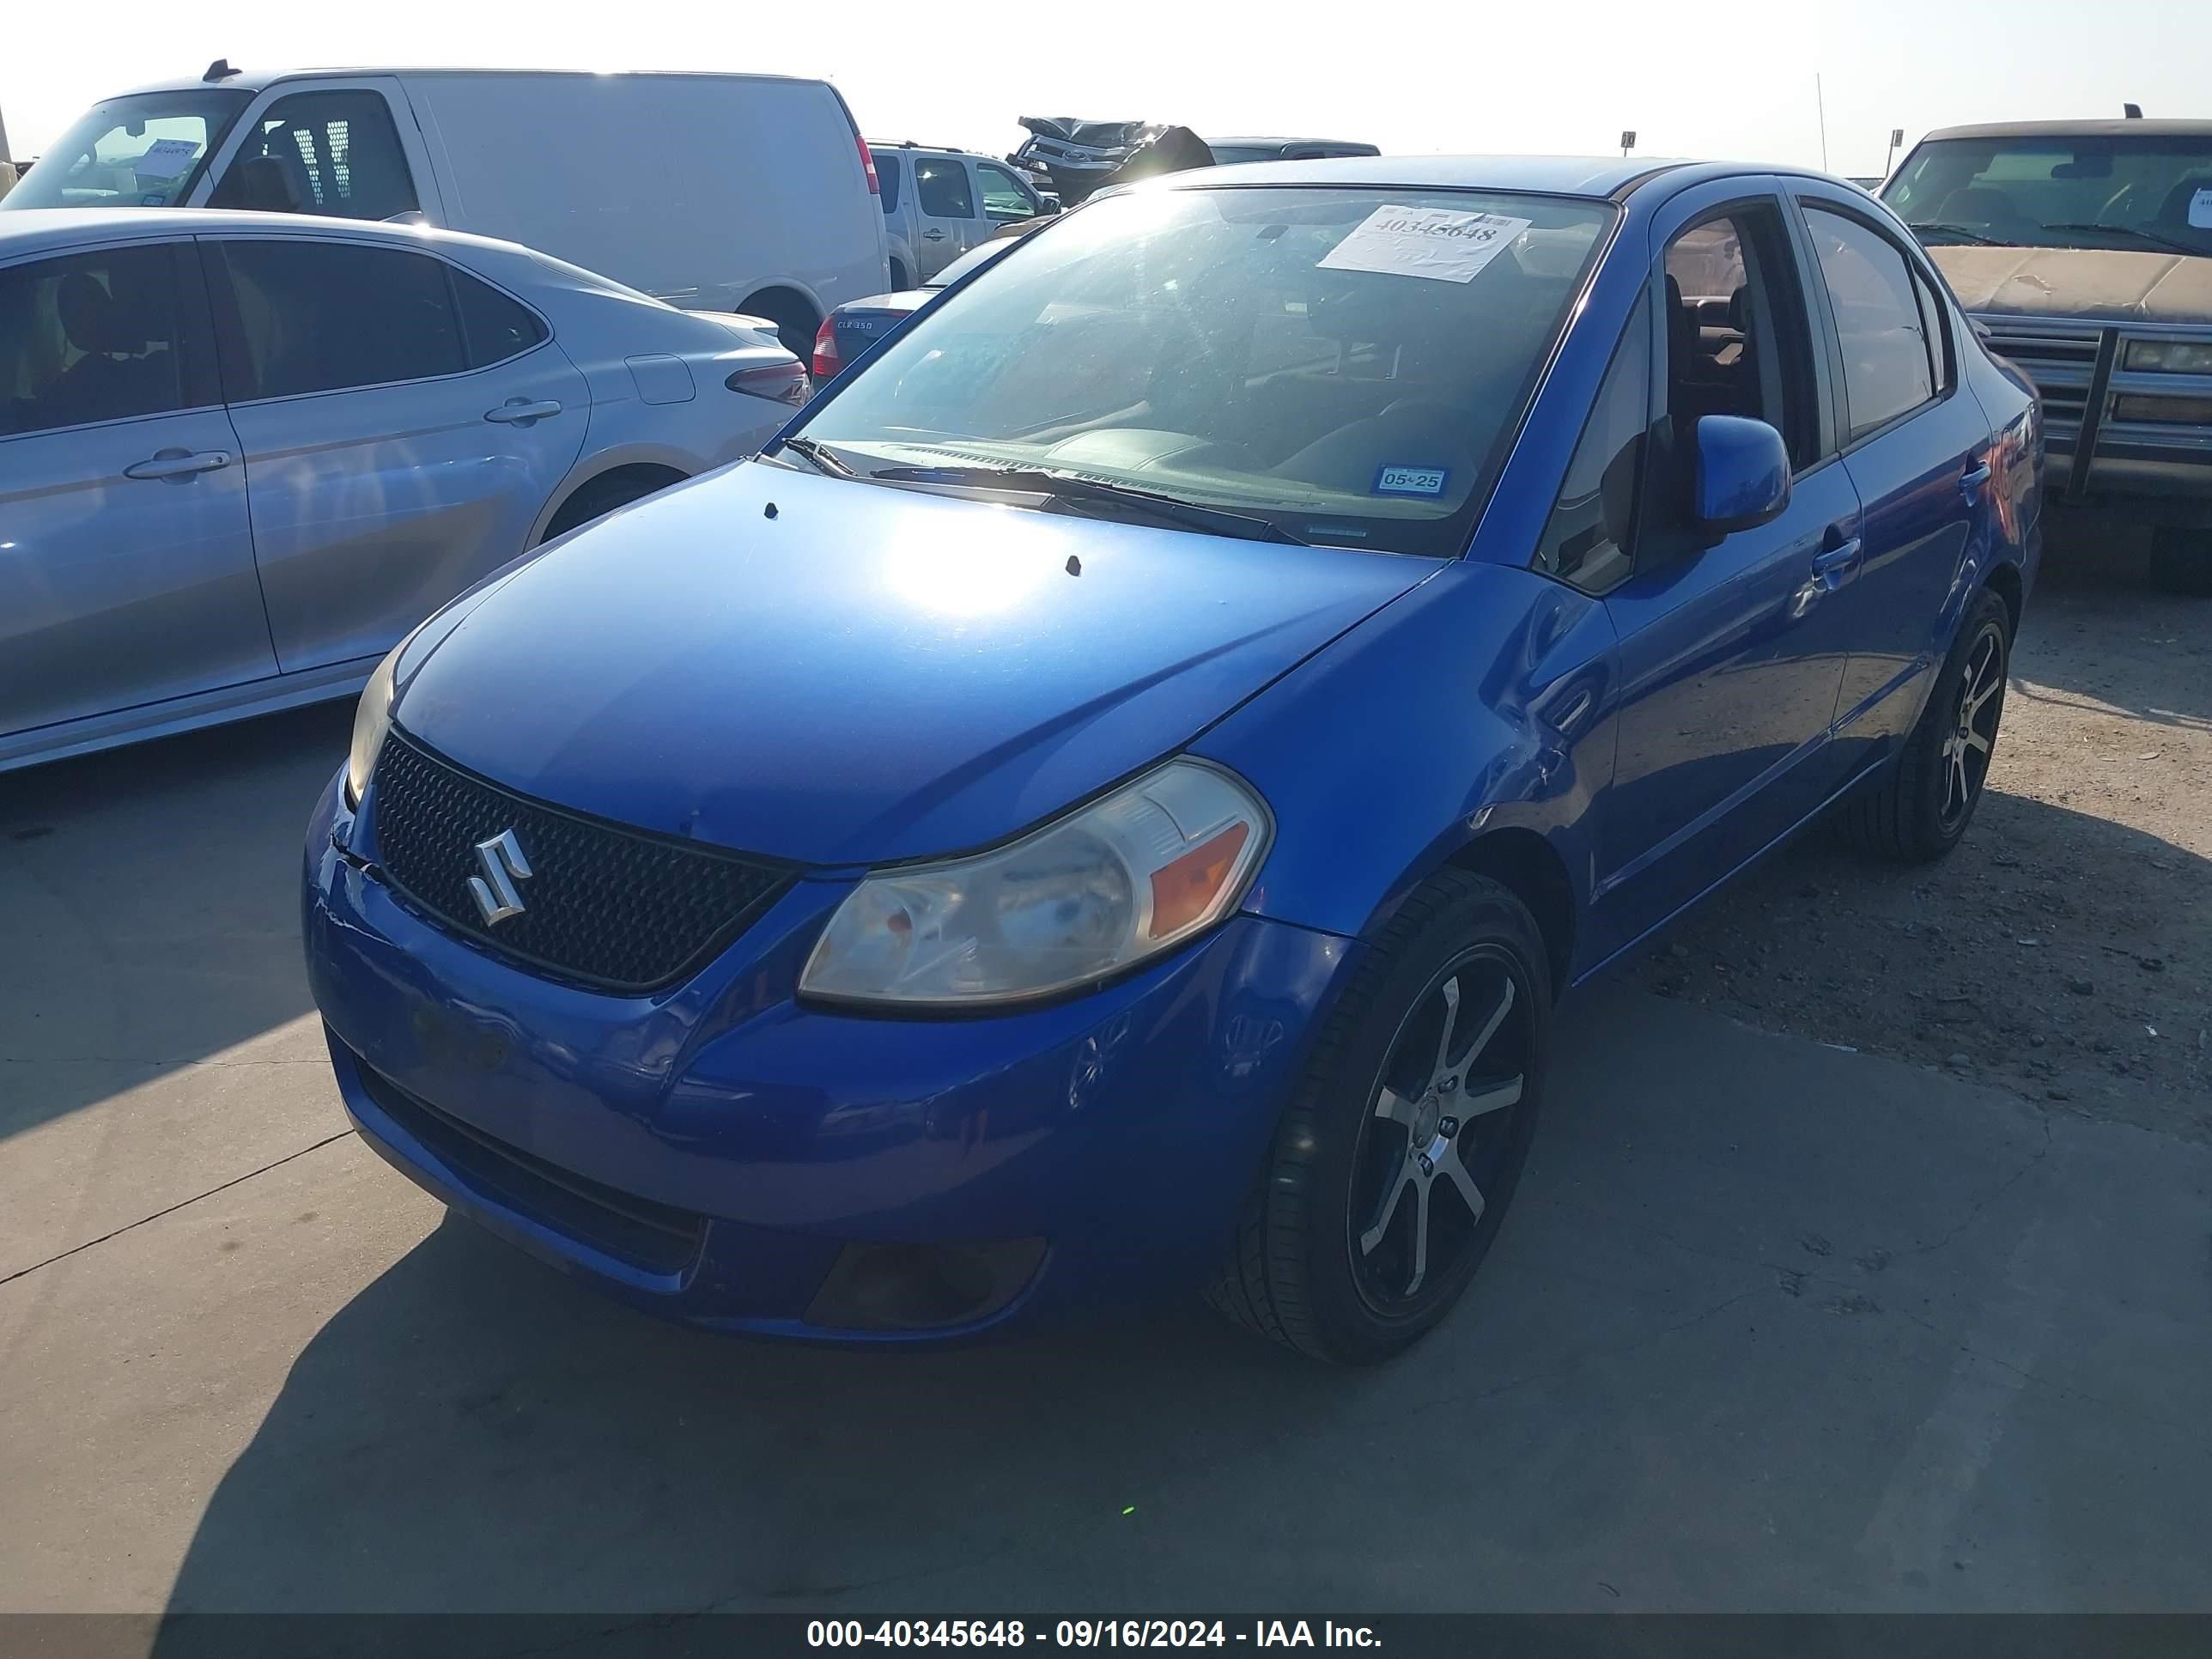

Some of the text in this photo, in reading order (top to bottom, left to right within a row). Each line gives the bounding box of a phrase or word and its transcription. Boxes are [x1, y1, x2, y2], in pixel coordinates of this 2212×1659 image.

[1376, 219, 1498, 241] 40345648
[1384, 473, 1440, 488] 05 25
